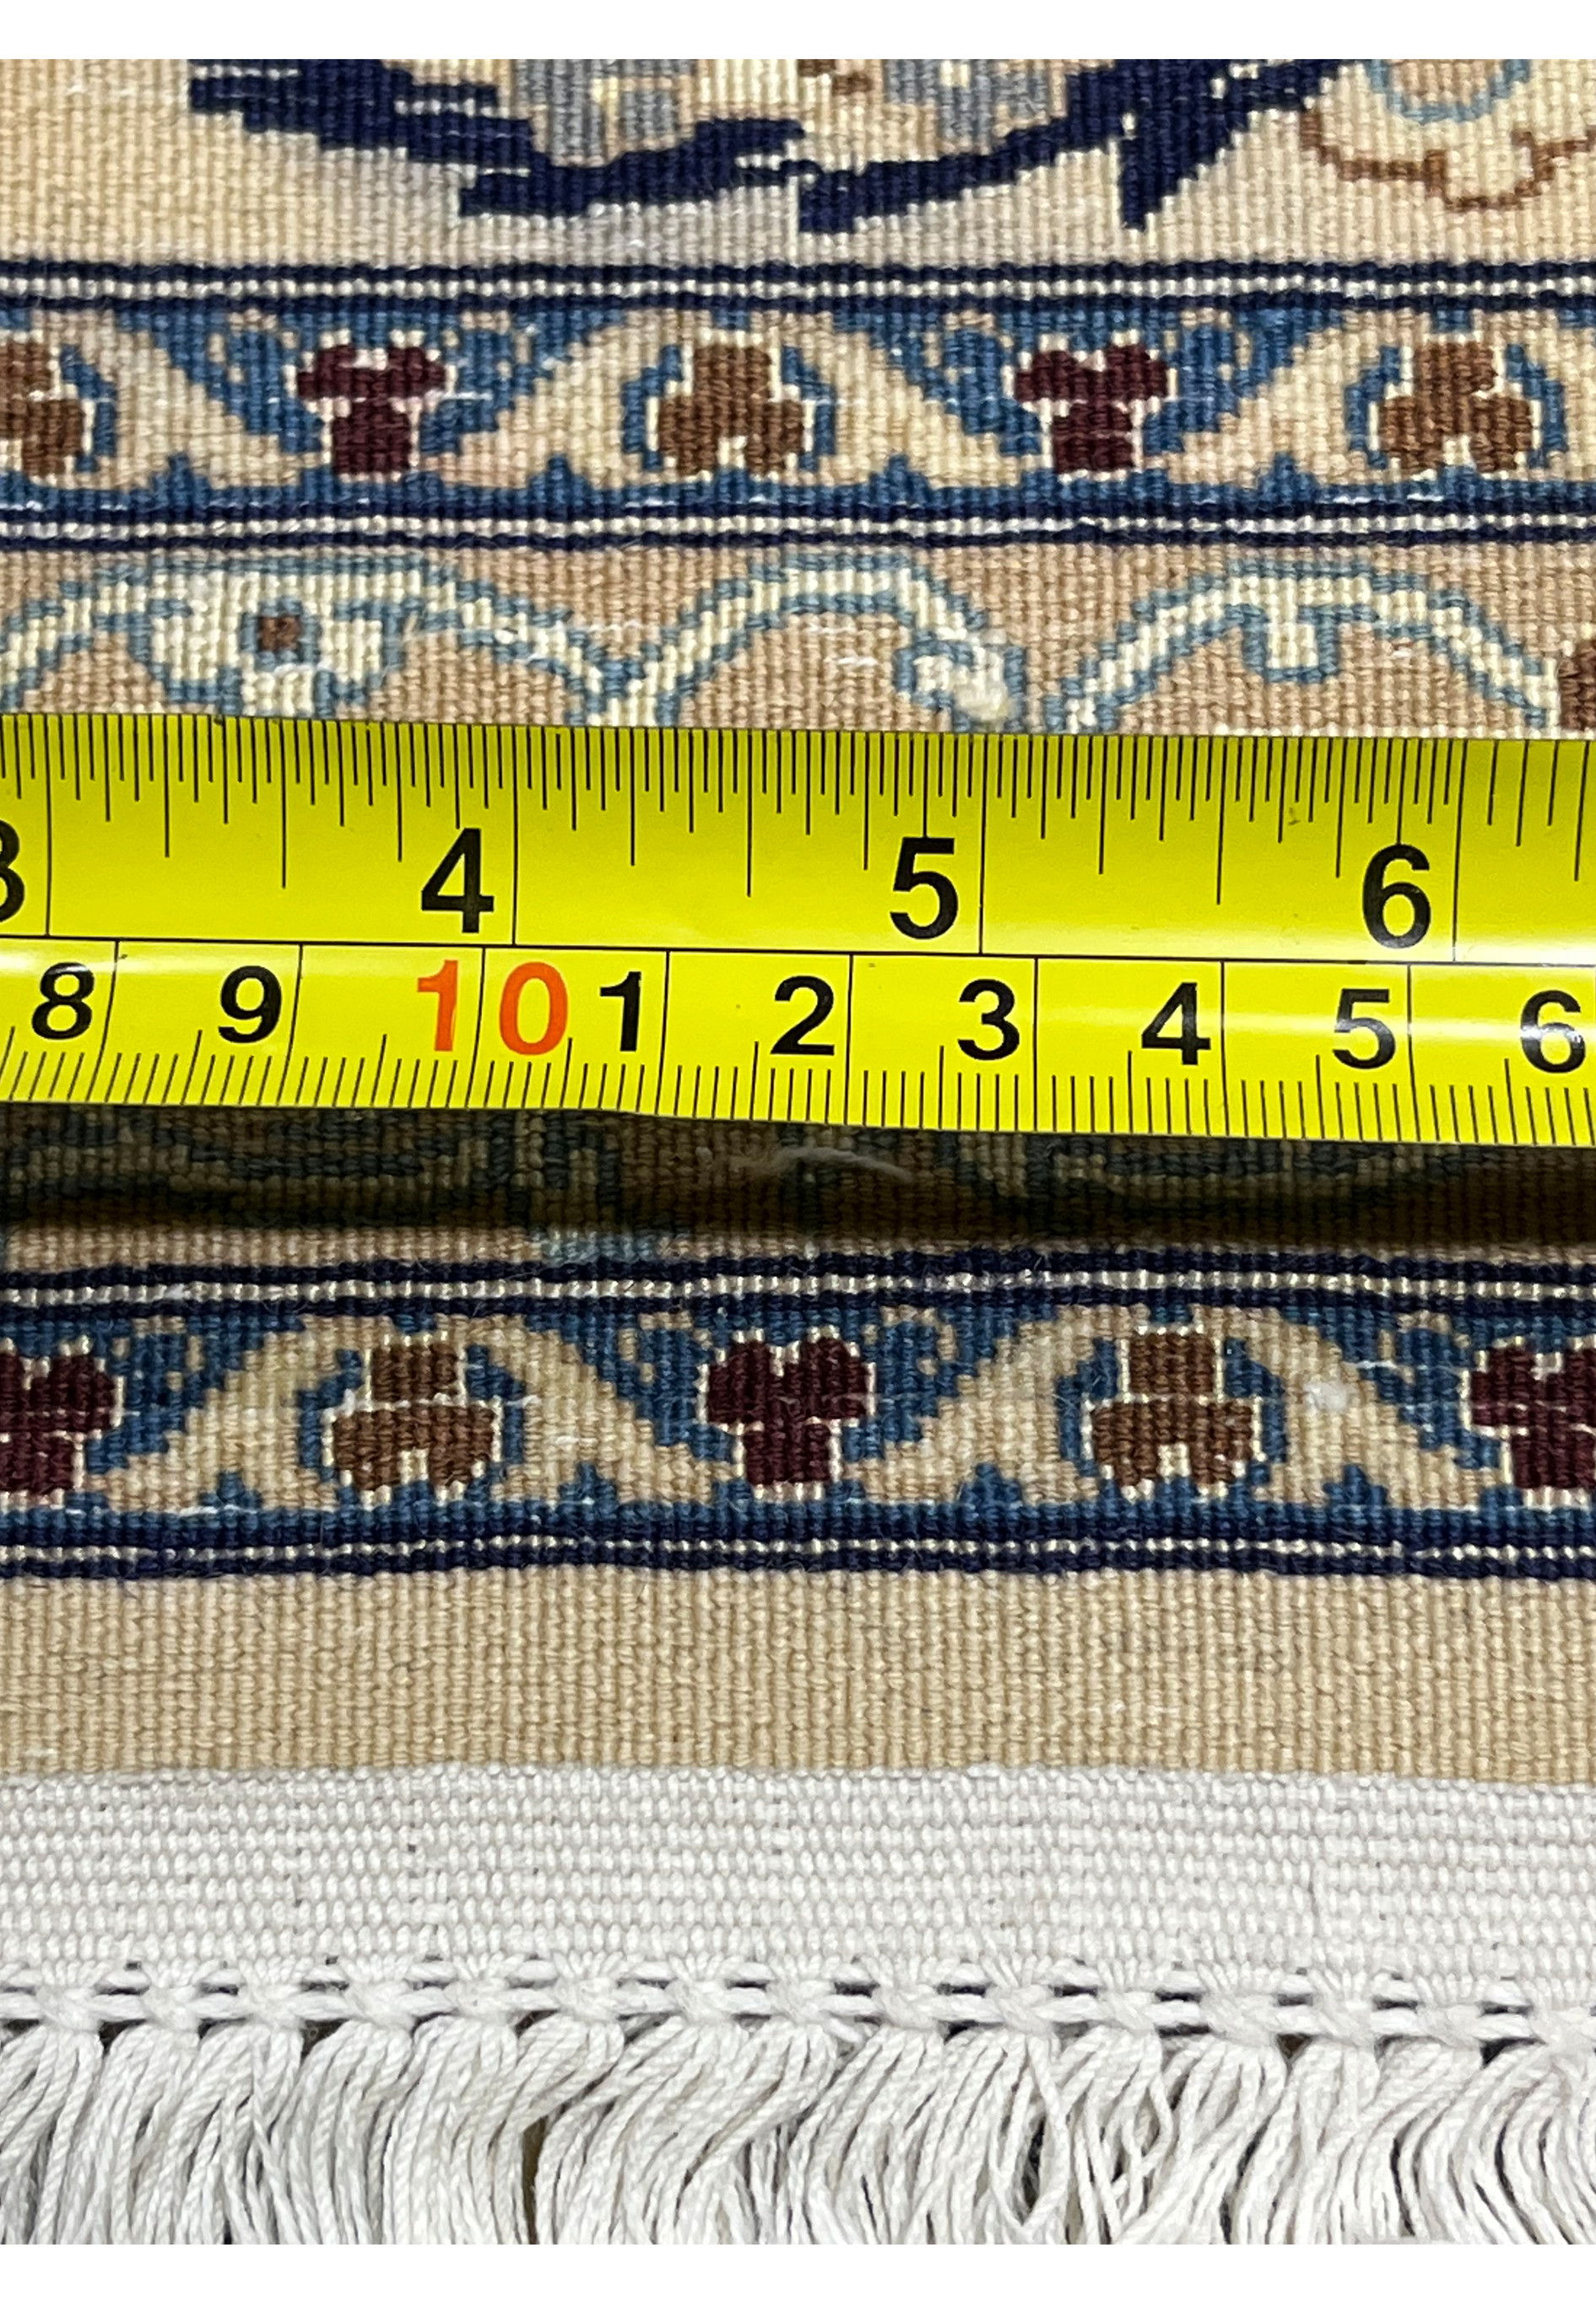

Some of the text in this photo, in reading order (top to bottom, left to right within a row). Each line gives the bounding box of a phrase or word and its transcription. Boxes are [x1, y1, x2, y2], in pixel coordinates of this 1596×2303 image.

[421, 827, 1431, 949] 4 5 6
[31, 960, 1586, 1073] 8 9 10 1 2 3 4 5 6
